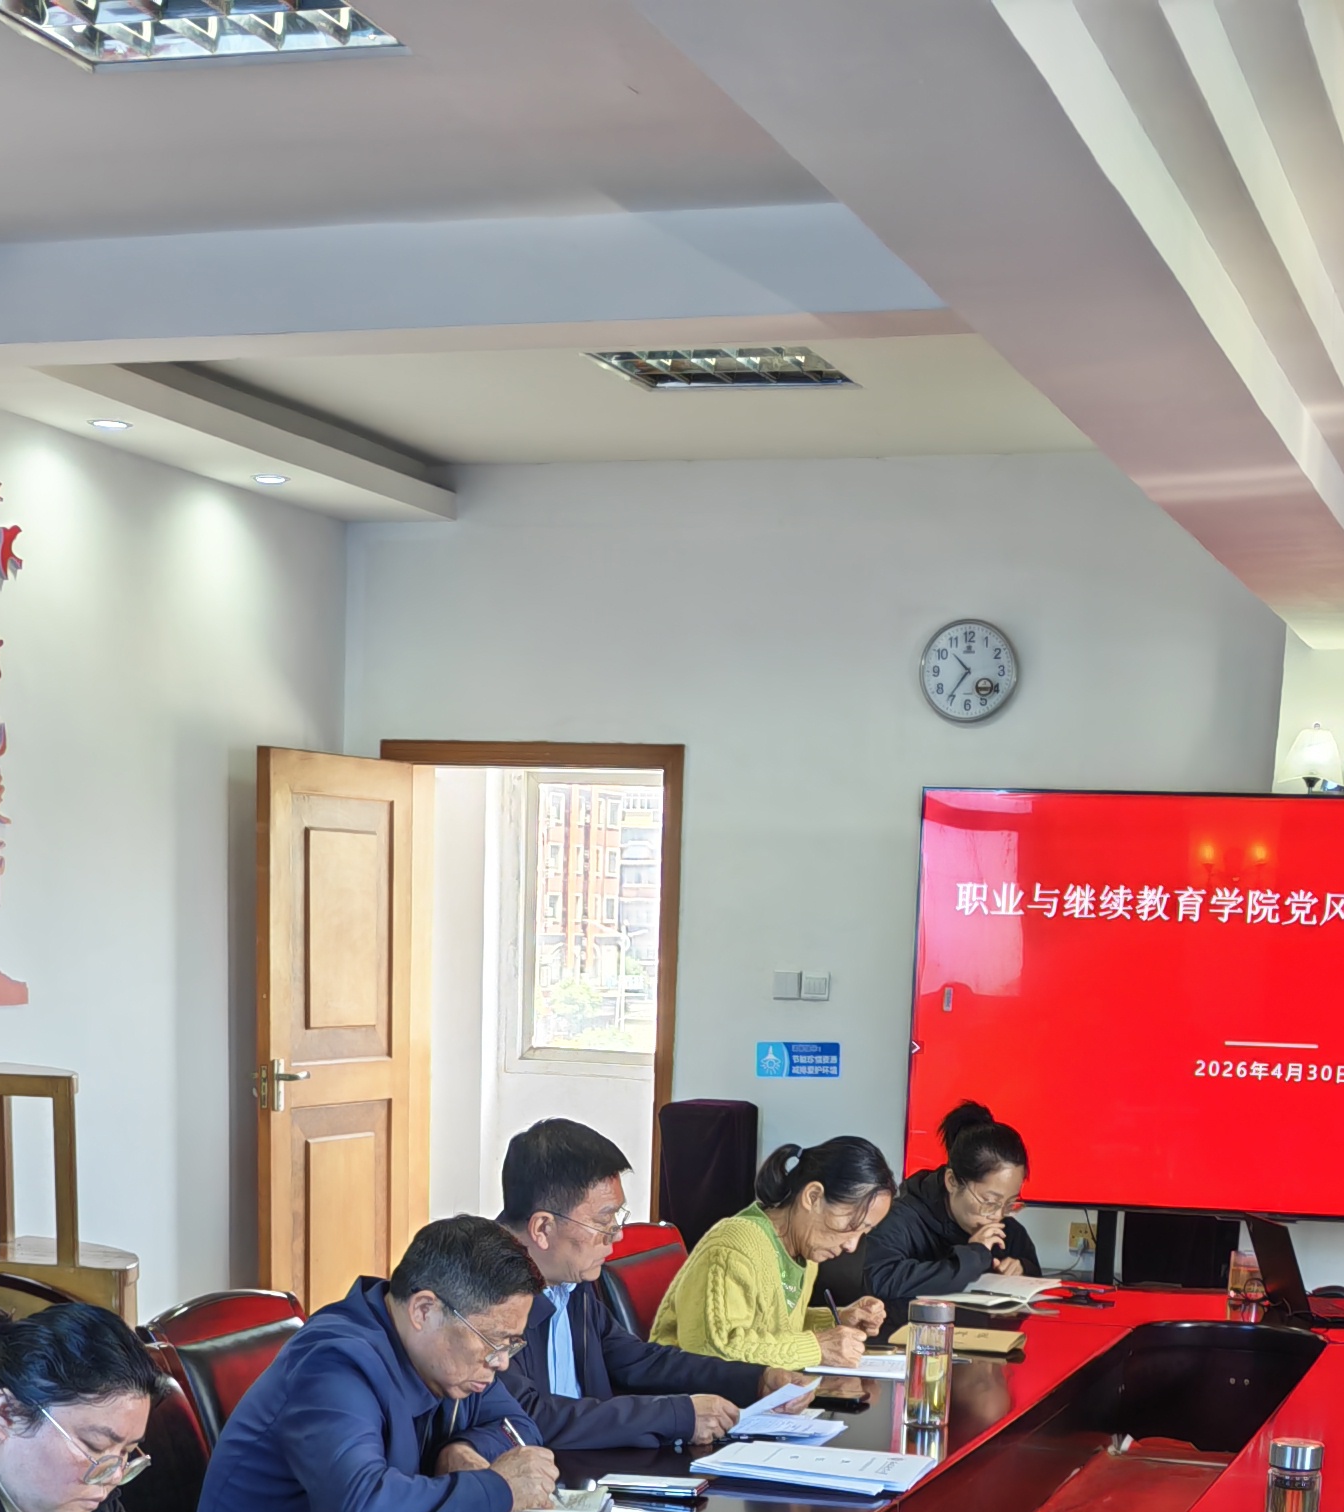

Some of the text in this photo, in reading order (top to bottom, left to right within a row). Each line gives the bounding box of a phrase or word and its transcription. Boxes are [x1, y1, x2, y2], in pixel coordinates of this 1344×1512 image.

[948, 637, 958, 648] 11
[963, 631, 975, 643] 12
[984, 637, 989, 648] 1
[937, 648, 948, 660] 10
[993, 648, 1001, 659] 2
[932, 666, 940, 677] 9
[998, 665, 1005, 677] 3
[936, 683, 944, 694] 8
[964, 699, 971, 711] 6
